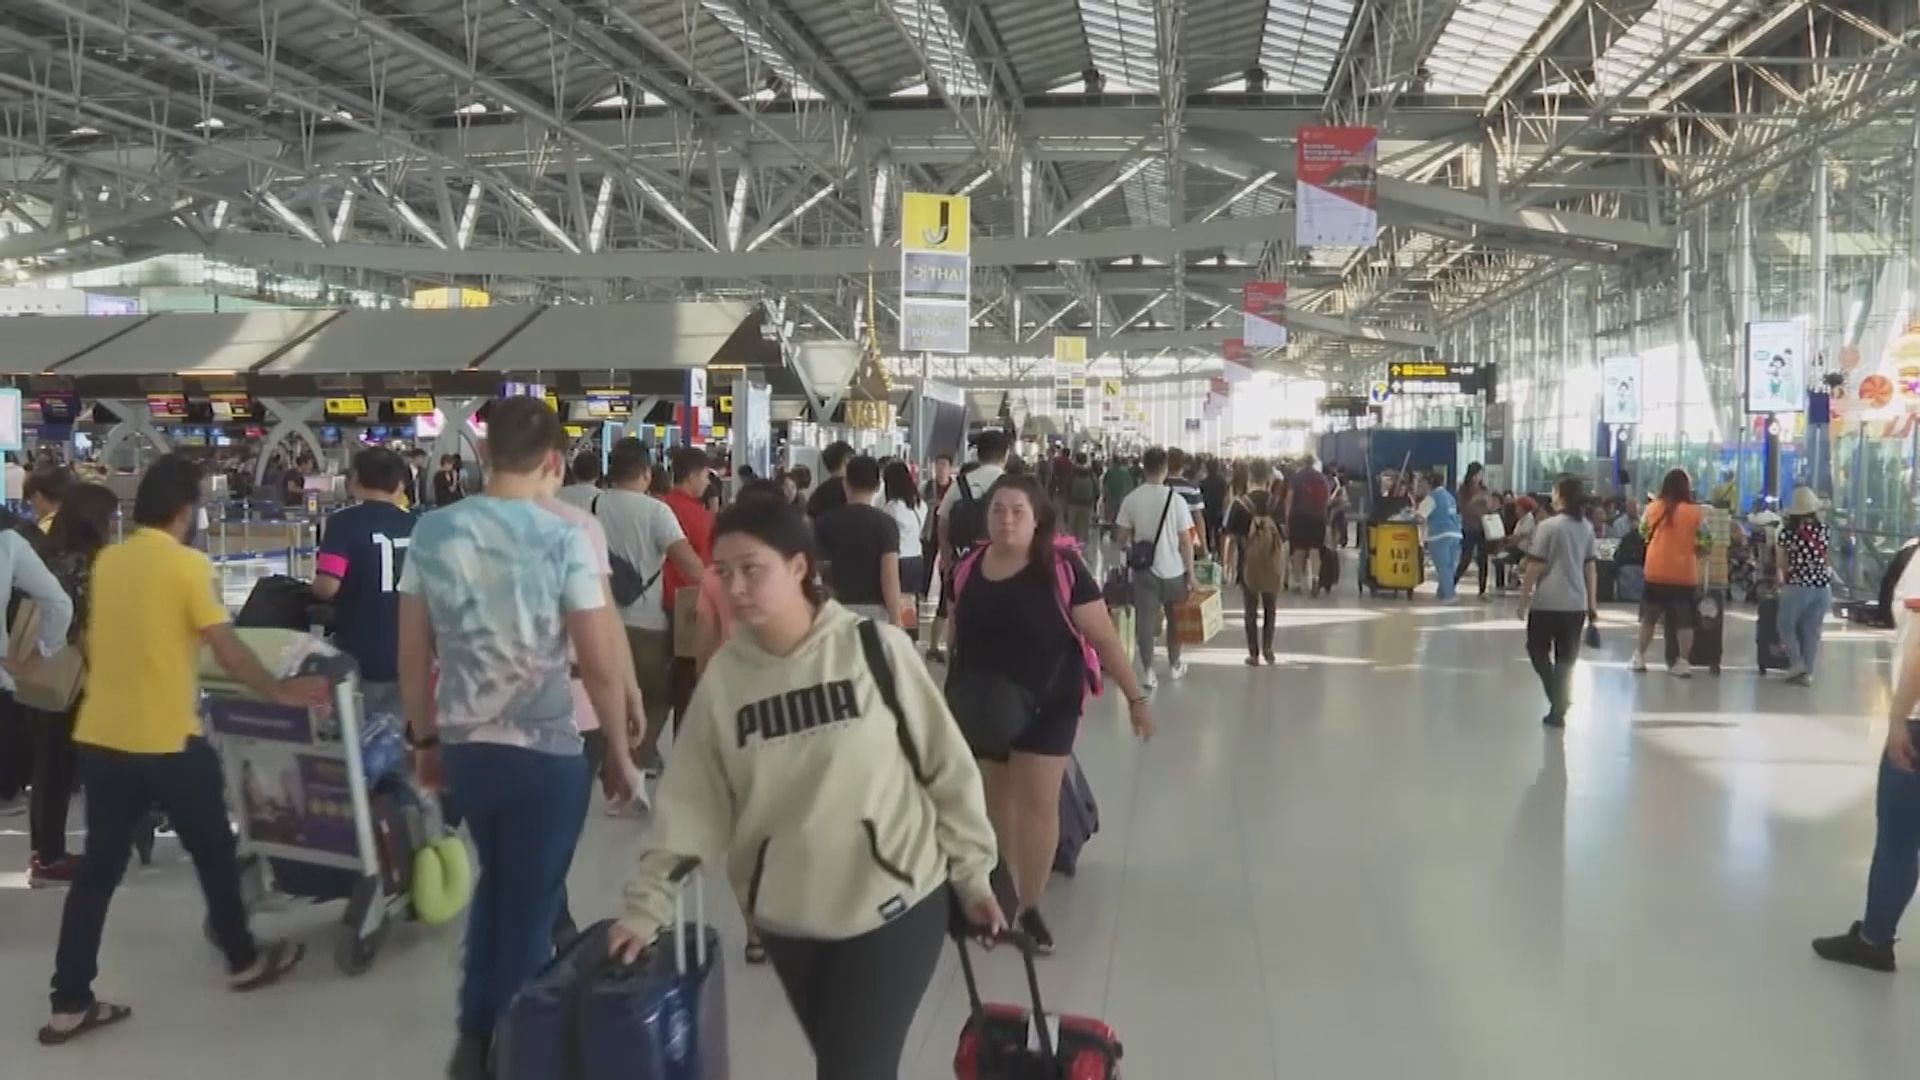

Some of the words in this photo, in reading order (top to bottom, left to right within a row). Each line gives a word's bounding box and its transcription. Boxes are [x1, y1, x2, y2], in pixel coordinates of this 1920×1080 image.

[922, 201, 950, 245] J
[929, 266, 963, 281] THAI
[736, 679, 861, 749] PUMA
